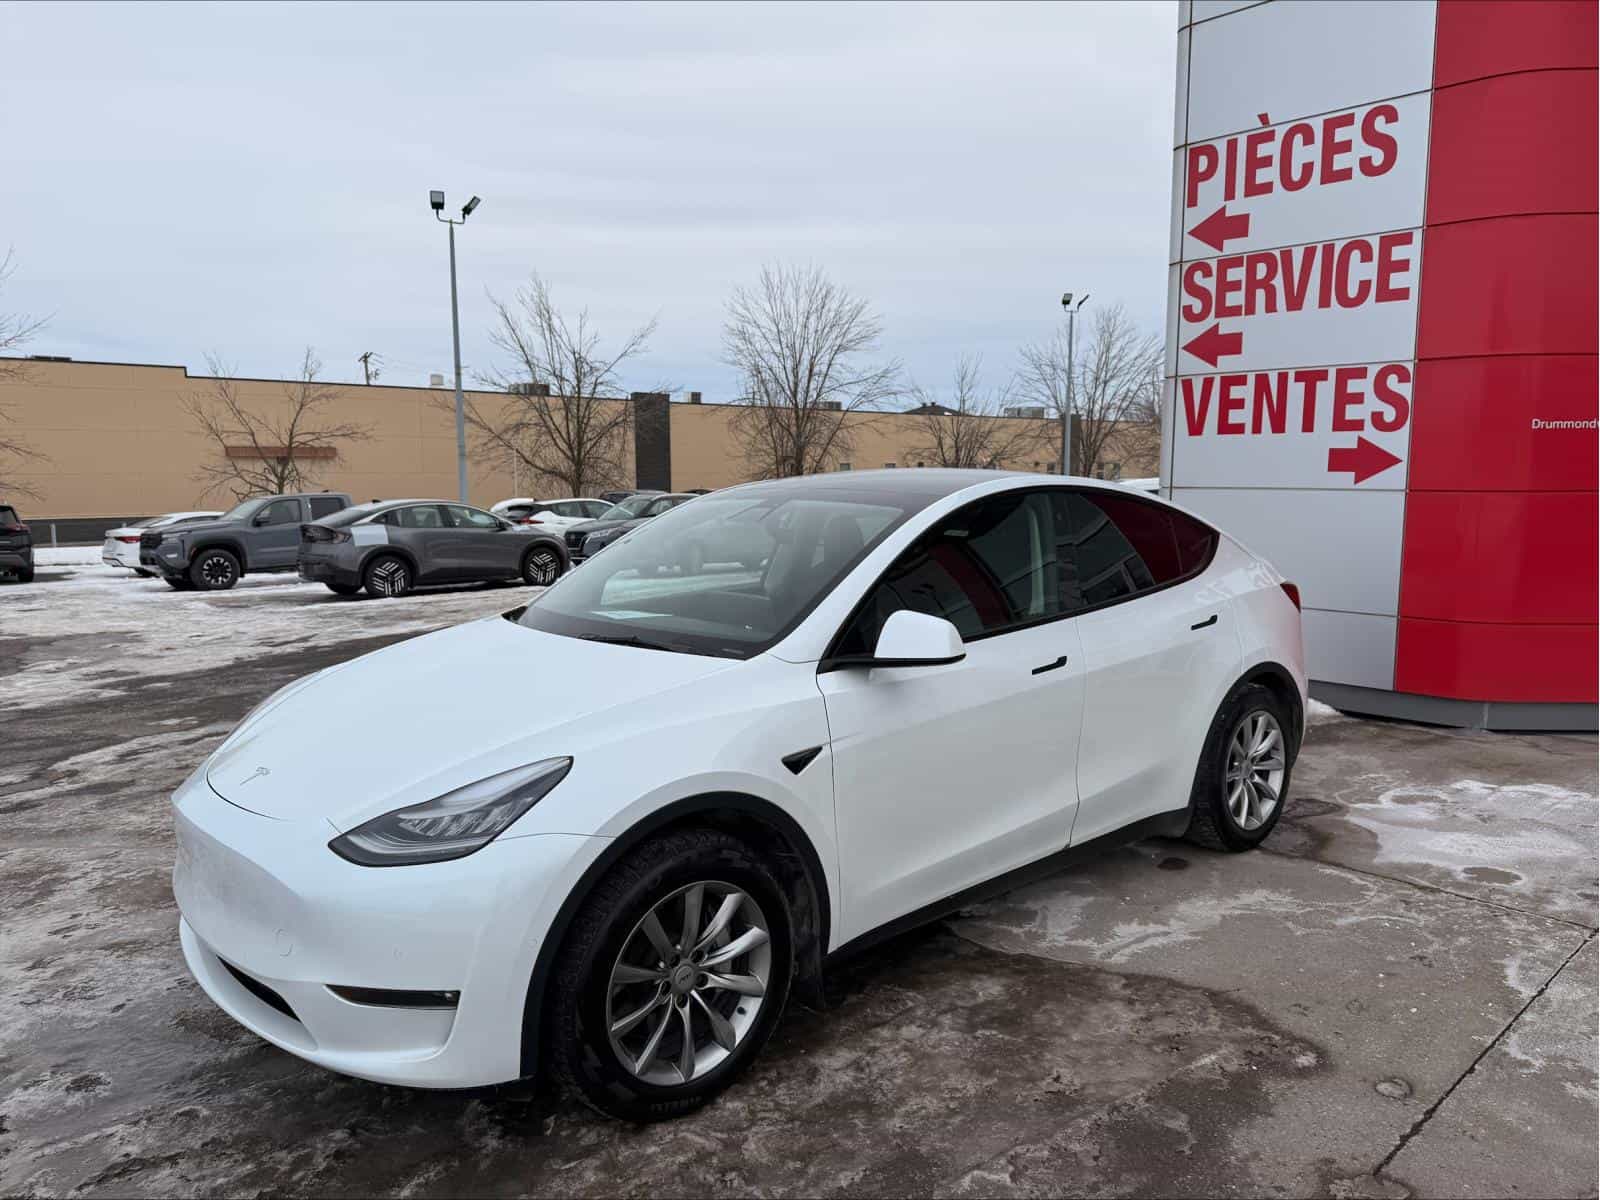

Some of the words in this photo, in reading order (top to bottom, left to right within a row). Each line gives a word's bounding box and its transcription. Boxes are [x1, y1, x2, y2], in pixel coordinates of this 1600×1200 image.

[1187, 105, 1399, 208] PIÈCES
[1182, 232, 1414, 323] SERVICE
[1181, 364, 1412, 437] VENTES
[1532, 418, 1600, 429] Drummond
